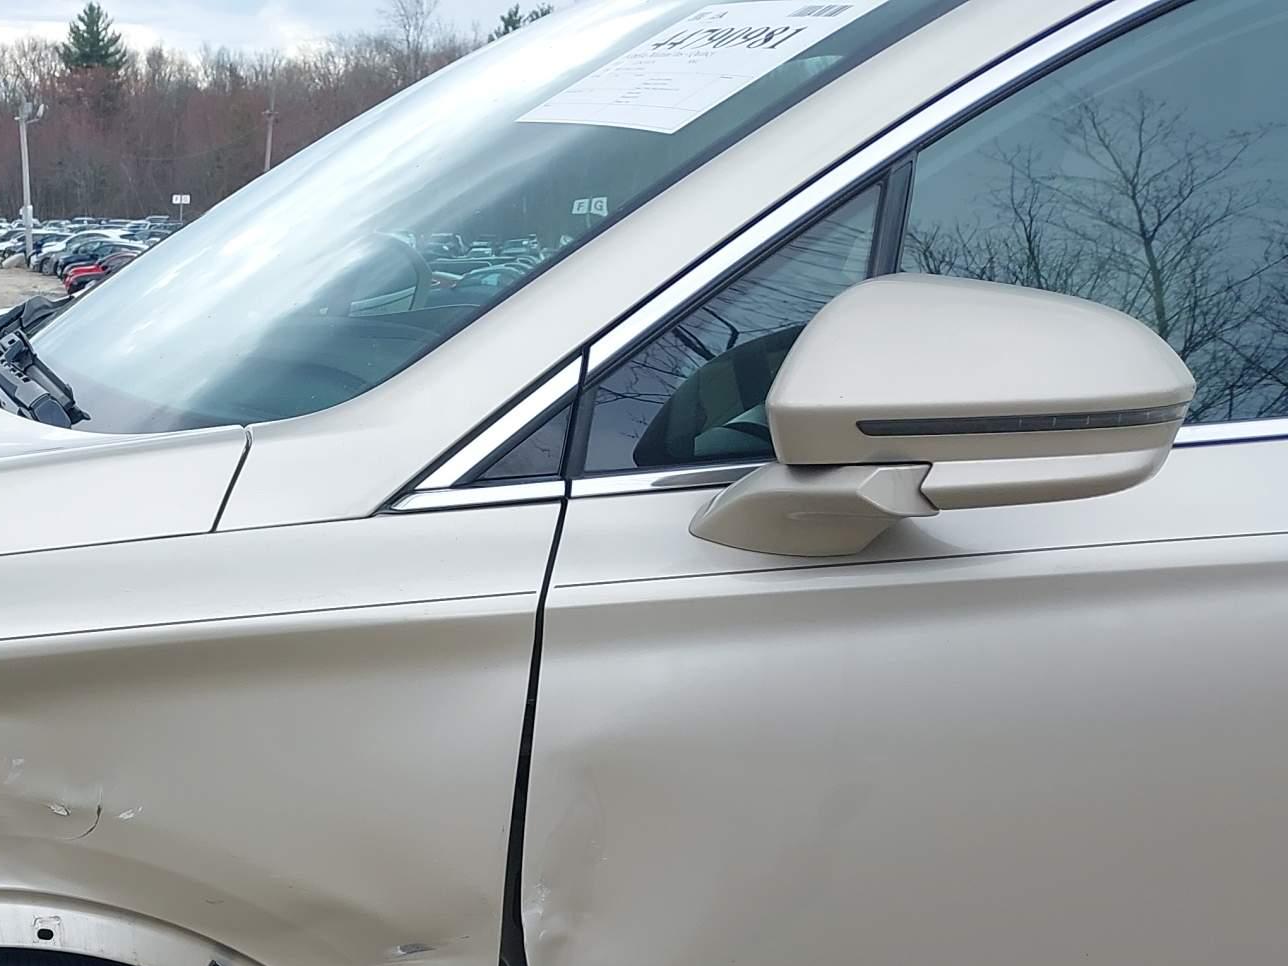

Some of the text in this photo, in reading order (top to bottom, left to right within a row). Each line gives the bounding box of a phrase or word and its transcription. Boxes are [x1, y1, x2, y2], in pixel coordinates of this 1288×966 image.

[651, 26, 808, 50] 44790981
[576, 200, 604, 211] F G
